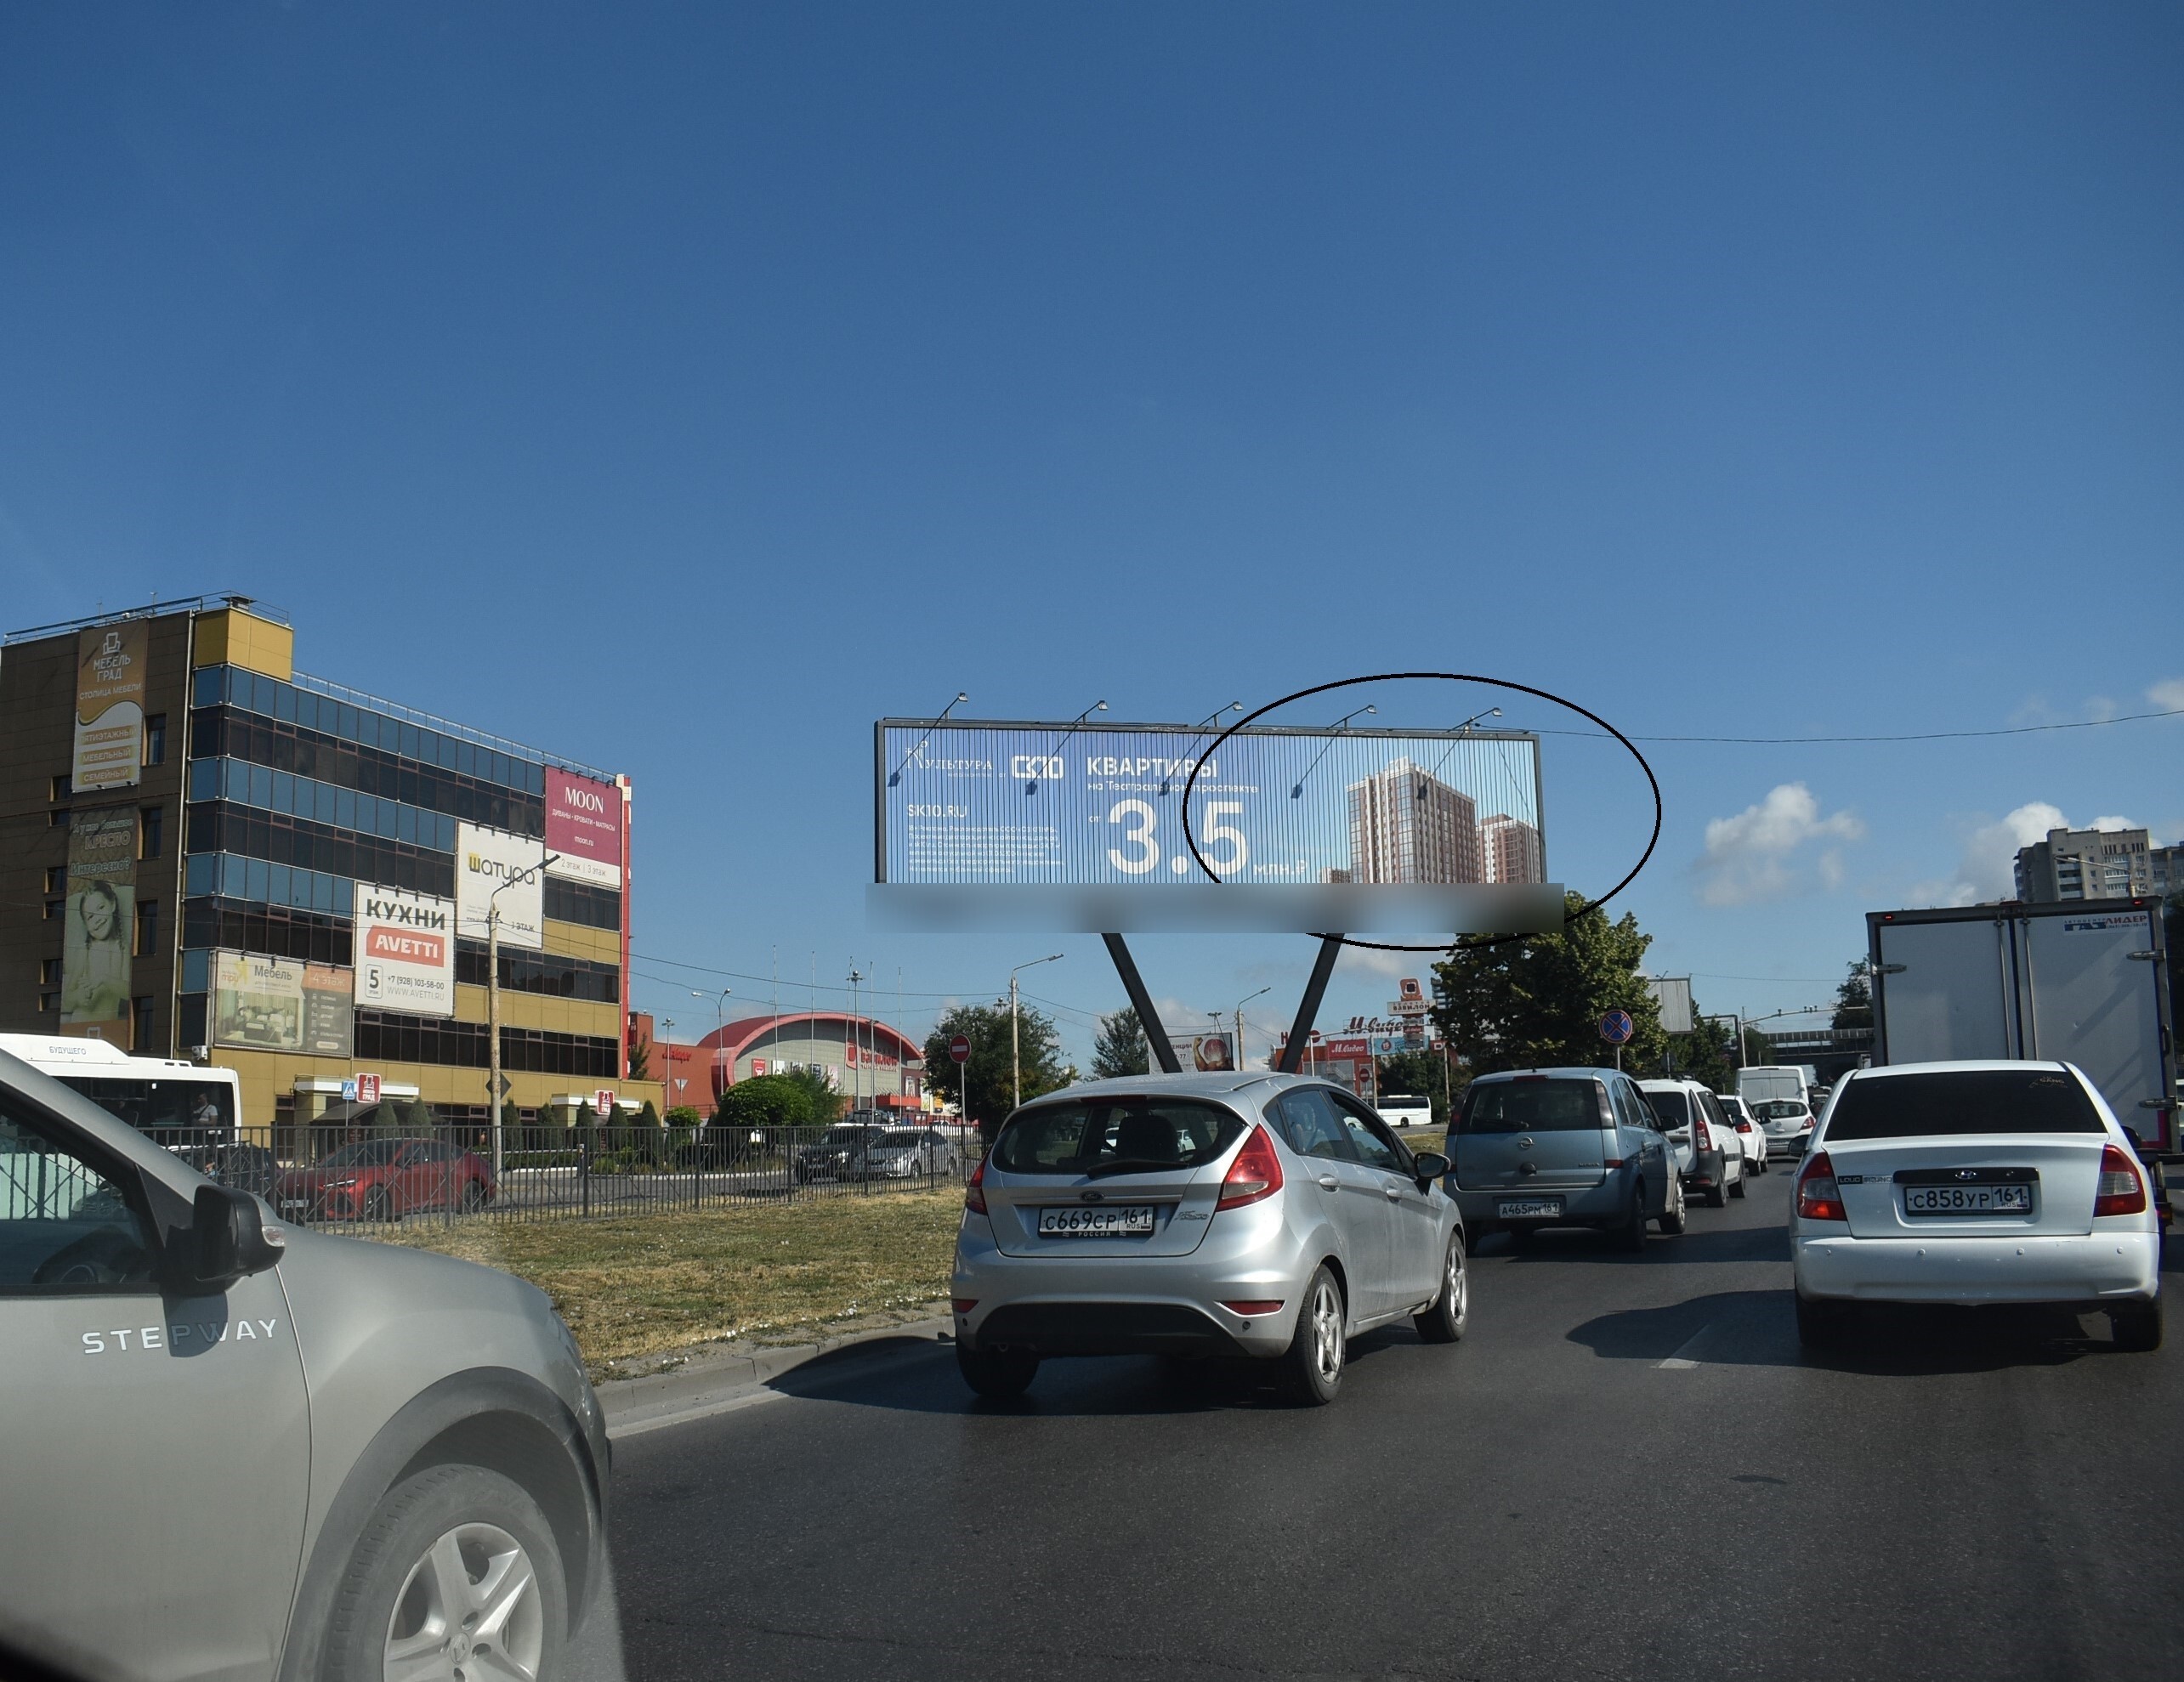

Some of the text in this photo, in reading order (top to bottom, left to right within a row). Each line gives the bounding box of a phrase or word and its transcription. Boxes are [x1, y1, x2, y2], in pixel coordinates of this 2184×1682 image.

[94, 654, 131, 671] МЕБЕЛЬ
[97, 668, 122, 682] ГРАД
[80, 683, 142, 699] СТОЛИЦА МЕБЕЛИ
[82, 748, 131, 762] МЕБЕЛЬНЫЙ
[83, 767, 128, 782] СЕМЕЙНЫЙ
[1087, 756, 1217, 778] КВАРТИРЫ
[1087, 782, 1103, 790] на
[1193, 783, 1258, 794] проспекте
[565, 787, 604, 813] MOON
[908, 804, 967, 818] SK10.RU
[101, 818, 133, 830] большое
[553, 808, 615, 831] ДИВАНЫ КРОВАТИ МАТРАСЫ
[85, 830, 131, 850] КРЕСЛО
[575, 836, 593, 847] moon.ru
[1108, 798, 1248, 875] 3.5
[71, 856, 131, 876] Интересно?
[469, 855, 535, 889] шатура
[561, 858, 606, 877] 2 этаж 3 этаж
[367, 898, 445, 930] КУХНИ
[2105, 915, 2147, 925] ЛИДЕР
[2064, 921, 2107, 932] ГАЗ
[376, 934, 438, 958] AVETTI
[254, 965, 292, 981] Мебель
[313, 973, 345, 987] 4 этаж
[369, 969, 379, 988] 5
[397, 977, 413, 987] (928)
[415, 978, 445, 989] 103-58-00
[388, 987, 445, 1001] WWW.AVETTI.RU
[1343, 1017, 1404, 1036] М.виде
[49, 1045, 87, 1056] БУДУЩЕГО
[1331, 1043, 1364, 1053] М.видео
[1913, 1188, 2023, 1208] С858УР 161
[1543, 1203, 1558, 1212] 161
[1046, 1209, 1148, 1230] С669СР 161
[82, 1318, 276, 1354] STEPWAY
